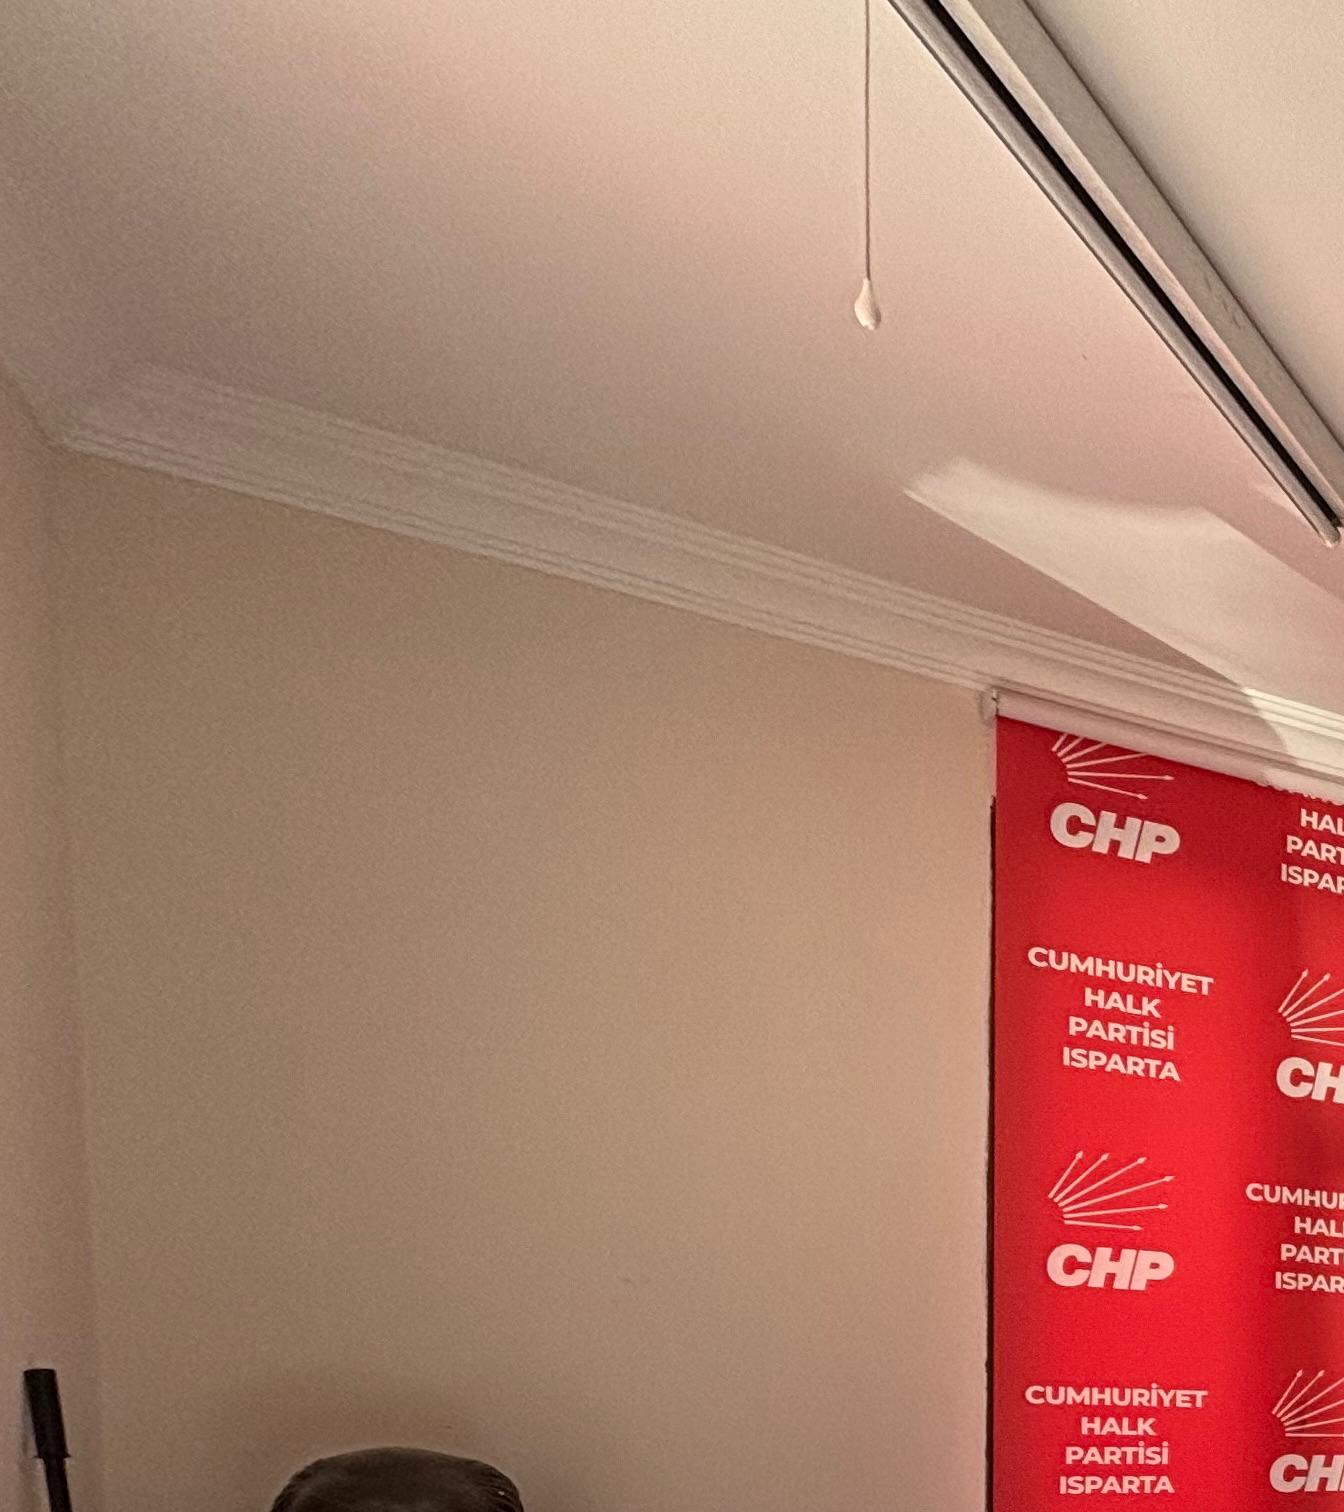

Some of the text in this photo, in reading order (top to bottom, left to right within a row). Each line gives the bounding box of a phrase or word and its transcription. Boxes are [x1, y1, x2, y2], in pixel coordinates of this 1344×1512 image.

[1051, 803, 1180, 863] CHP
[1028, 947, 1214, 995] CUMHURİYET
[1085, 988, 1161, 1018] HALK
[1069, 1016, 1174, 1050] PARTİSİ
[1063, 1047, 1180, 1081] ISPARTA
[1047, 1244, 1174, 1290] CHP
[1025, 1383, 1208, 1407] CUMHURİYET
[1081, 1417, 1156, 1435] HALK
[1066, 1441, 1168, 1464] PARTİSİ
[1060, 1476, 1174, 1494] ISPARTA
